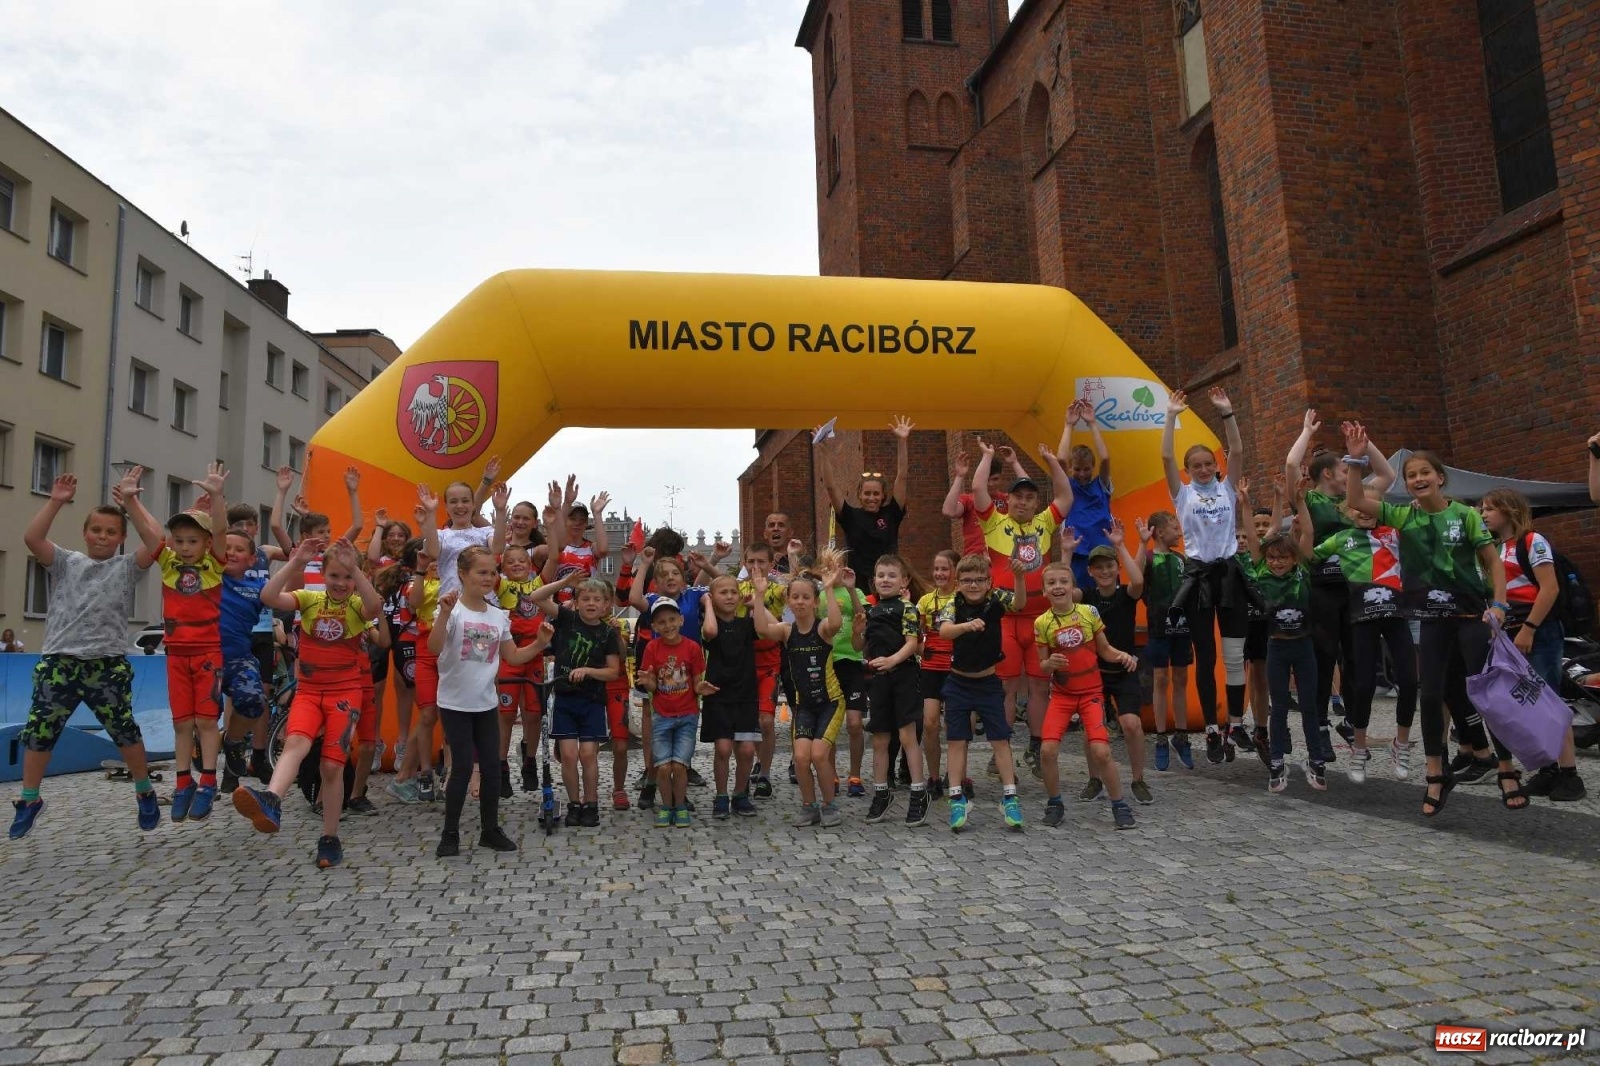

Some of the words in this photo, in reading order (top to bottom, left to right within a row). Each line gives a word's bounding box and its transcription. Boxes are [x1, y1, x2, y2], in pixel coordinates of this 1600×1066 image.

[629, 320, 775, 352] MIASTO
[788, 320, 977, 355] RACIBÓRZ
[1095, 398, 1165, 430] Racibórz
